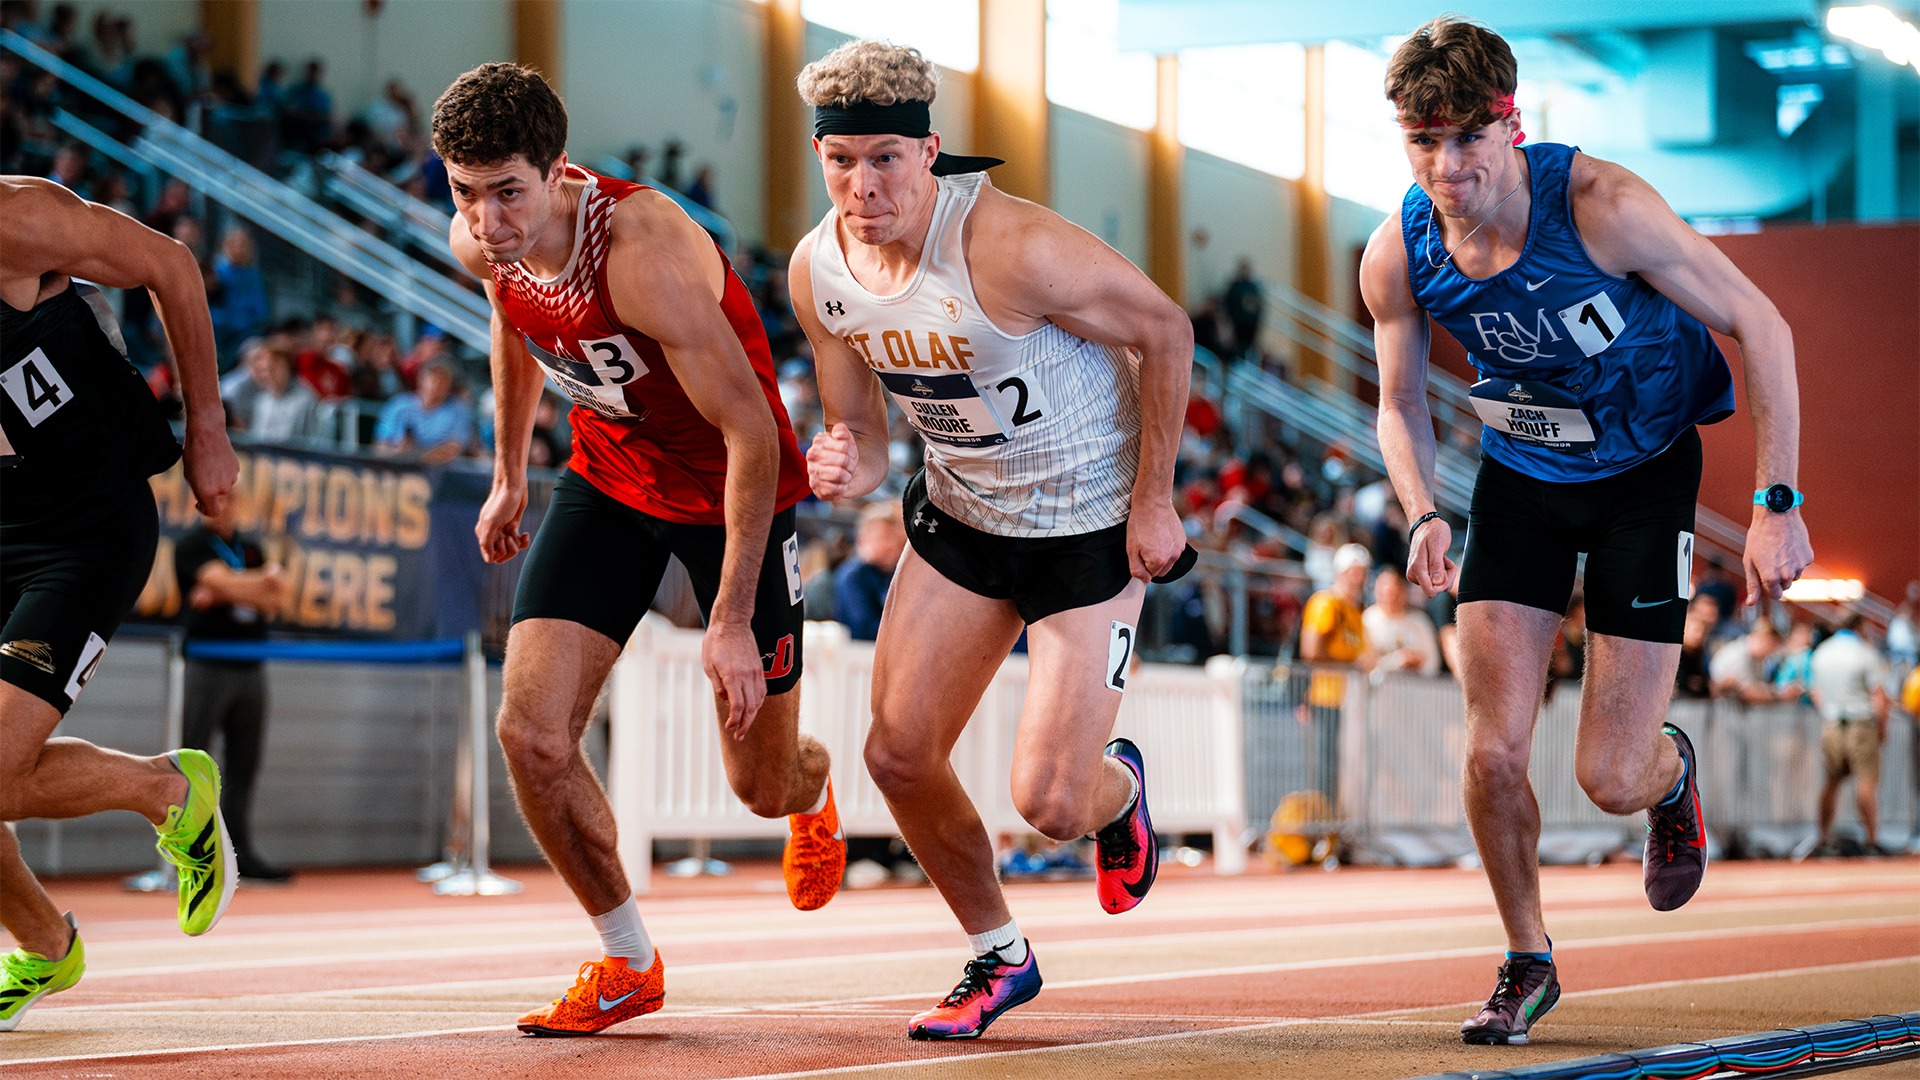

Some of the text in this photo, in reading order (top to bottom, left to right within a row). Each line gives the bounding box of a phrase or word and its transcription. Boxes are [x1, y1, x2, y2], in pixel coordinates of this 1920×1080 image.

[1470, 308, 1563, 363] F&M
[1578, 302, 1615, 344] 1
[591, 342, 635, 384] 3
[882, 330, 975, 370] OLAF
[22, 359, 62, 411] 4
[996, 376, 1043, 427] 2
[911, 401, 960, 417] CULLEN
[916, 414, 975, 434] MOORE
[1505, 418, 1561, 438] HOUFF
[1507, 407, 1547, 421] ZACH
[1683, 537, 1691, 597] 1
[1112, 628, 1131, 689] 2
